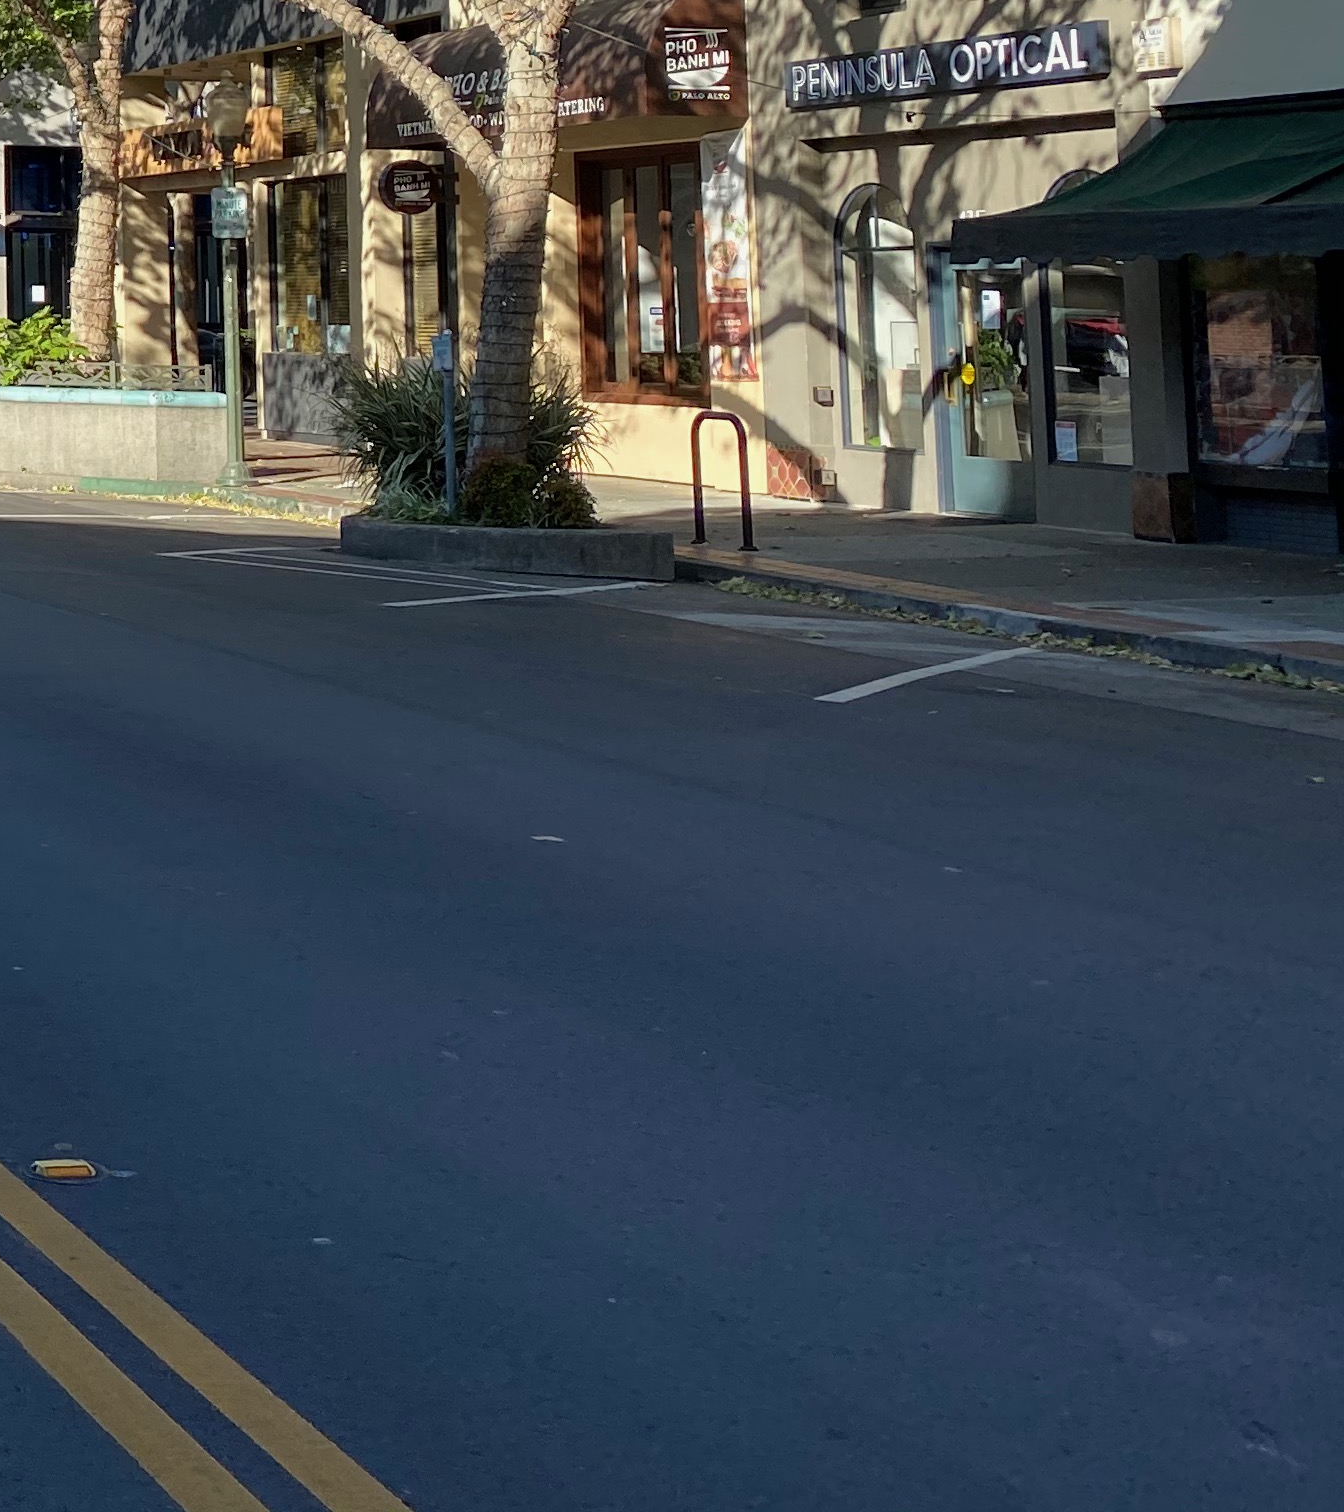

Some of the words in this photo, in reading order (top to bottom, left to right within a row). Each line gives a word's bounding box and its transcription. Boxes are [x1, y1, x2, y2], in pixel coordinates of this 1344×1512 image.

[665, 38, 697, 56] PHO
[666, 52, 709, 72] BANH
[713, 50, 730, 66] MI
[791, 48, 936, 102] PENINSULA
[949, 28, 1089, 83] OPTICAL
[476, 71, 489, 93] &
[682, 92, 705, 100] PALO
[707, 92, 730, 100] ALTO
[557, 97, 605, 117] ATERING
[393, 176, 412, 184] PHO
